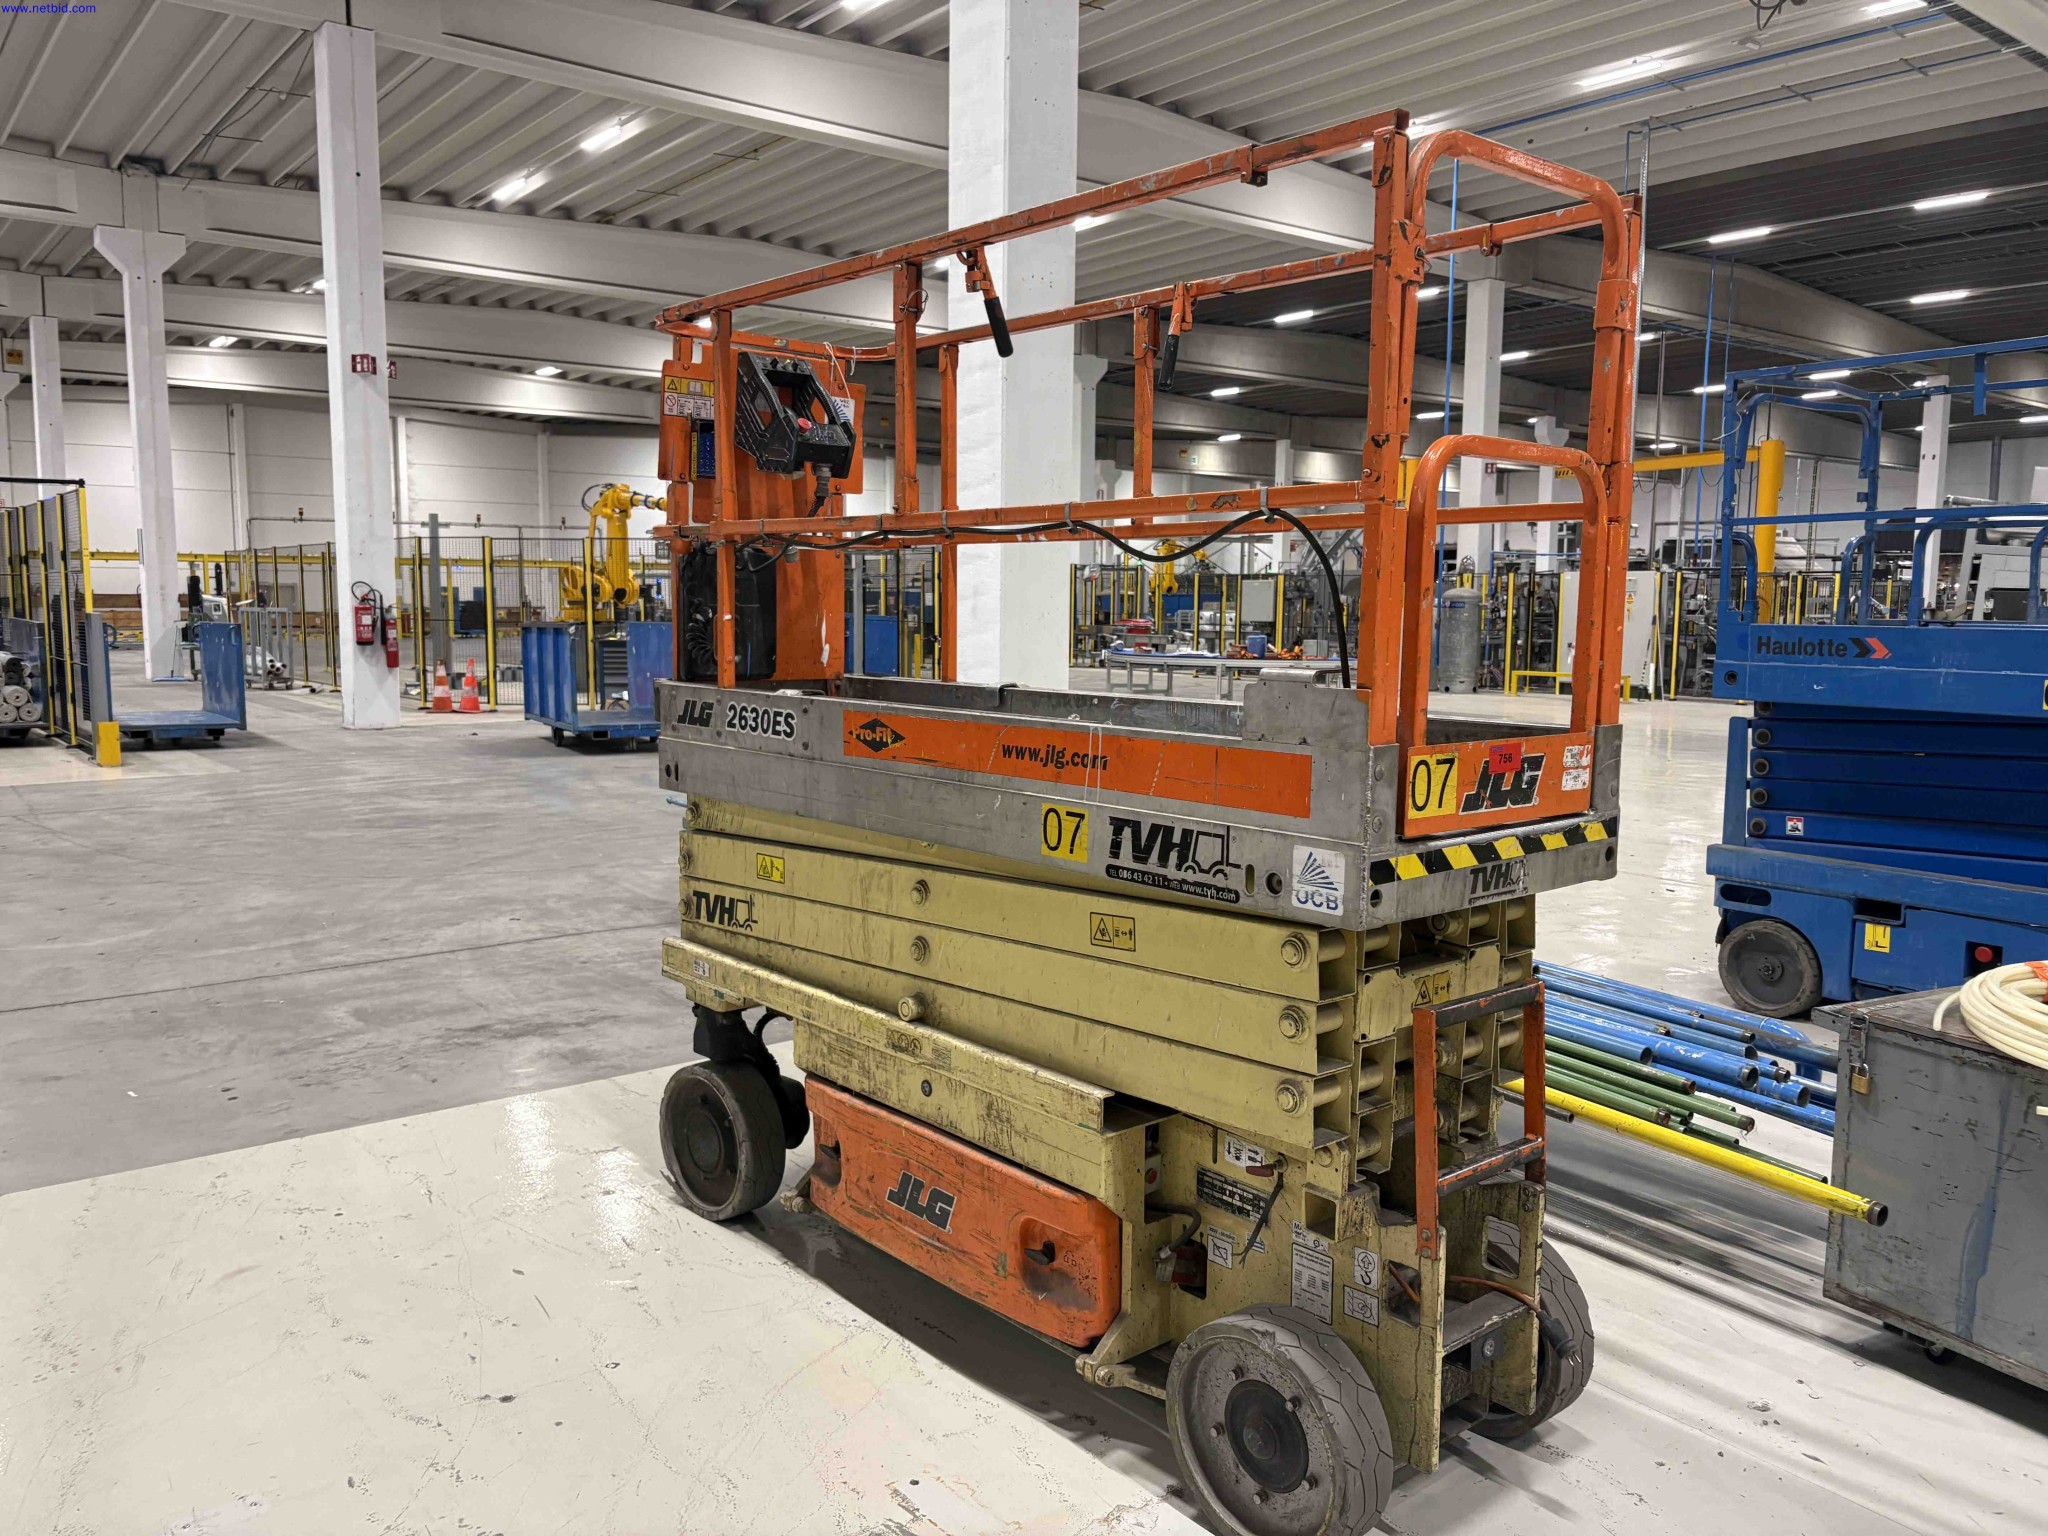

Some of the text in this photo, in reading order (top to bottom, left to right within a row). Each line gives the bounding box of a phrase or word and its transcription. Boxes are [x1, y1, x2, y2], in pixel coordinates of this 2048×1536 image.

[1757, 635, 1848, 658] Haulotte
[676, 699, 798, 741] JLG 2630ES
[1001, 744, 1110, 771] www.jlg.com
[1498, 753, 1513, 765] 756
[1411, 757, 1456, 812] 07
[1459, 752, 1547, 816] JLG
[1043, 807, 1195, 872] 07 TVH
[1109, 868, 1118, 877] TEL
[1132, 871, 1143, 882] 43
[1143, 874, 1154, 885] 42
[1154, 876, 1164, 886] 11
[1469, 863, 1512, 895] TVH
[692, 889, 736, 927] TVH
[885, 1169, 957, 1232] JLG
